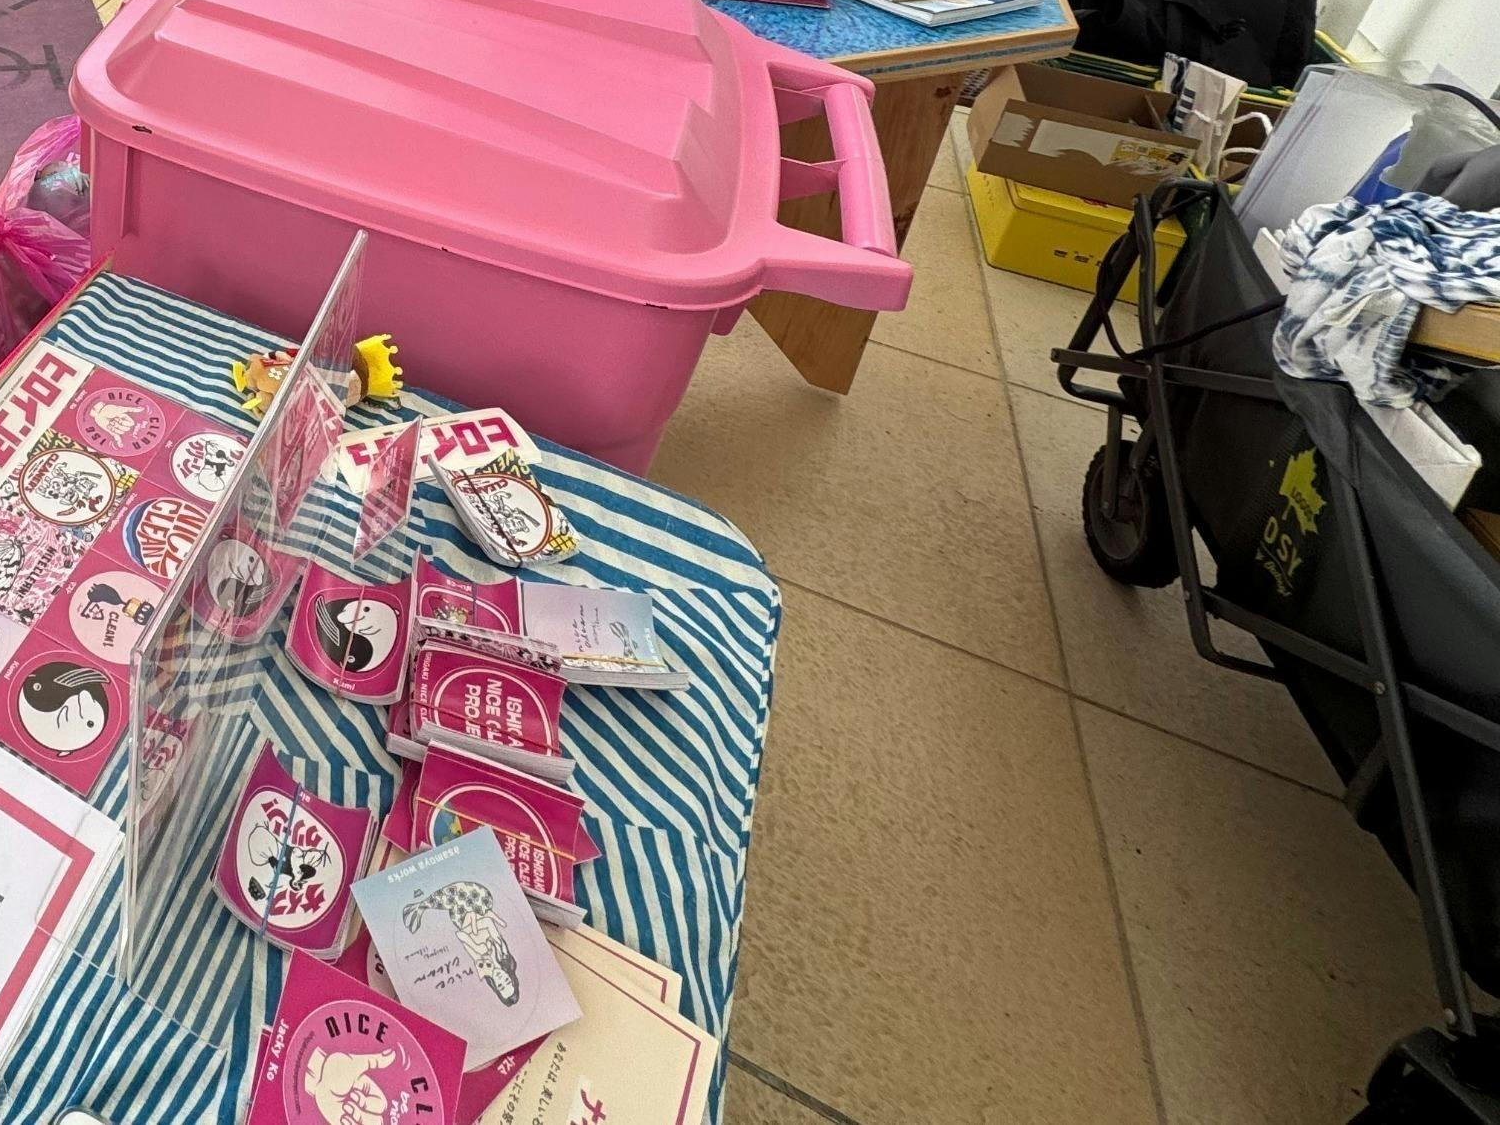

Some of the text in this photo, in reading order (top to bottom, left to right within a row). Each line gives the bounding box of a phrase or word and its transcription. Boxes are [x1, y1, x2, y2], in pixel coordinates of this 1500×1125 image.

[487, 677, 504, 716] NICE
[387, 866, 418, 884] works
[325, 1012, 389, 1043] NICE
[266, 1018, 290, 1082] Jacky Ko
